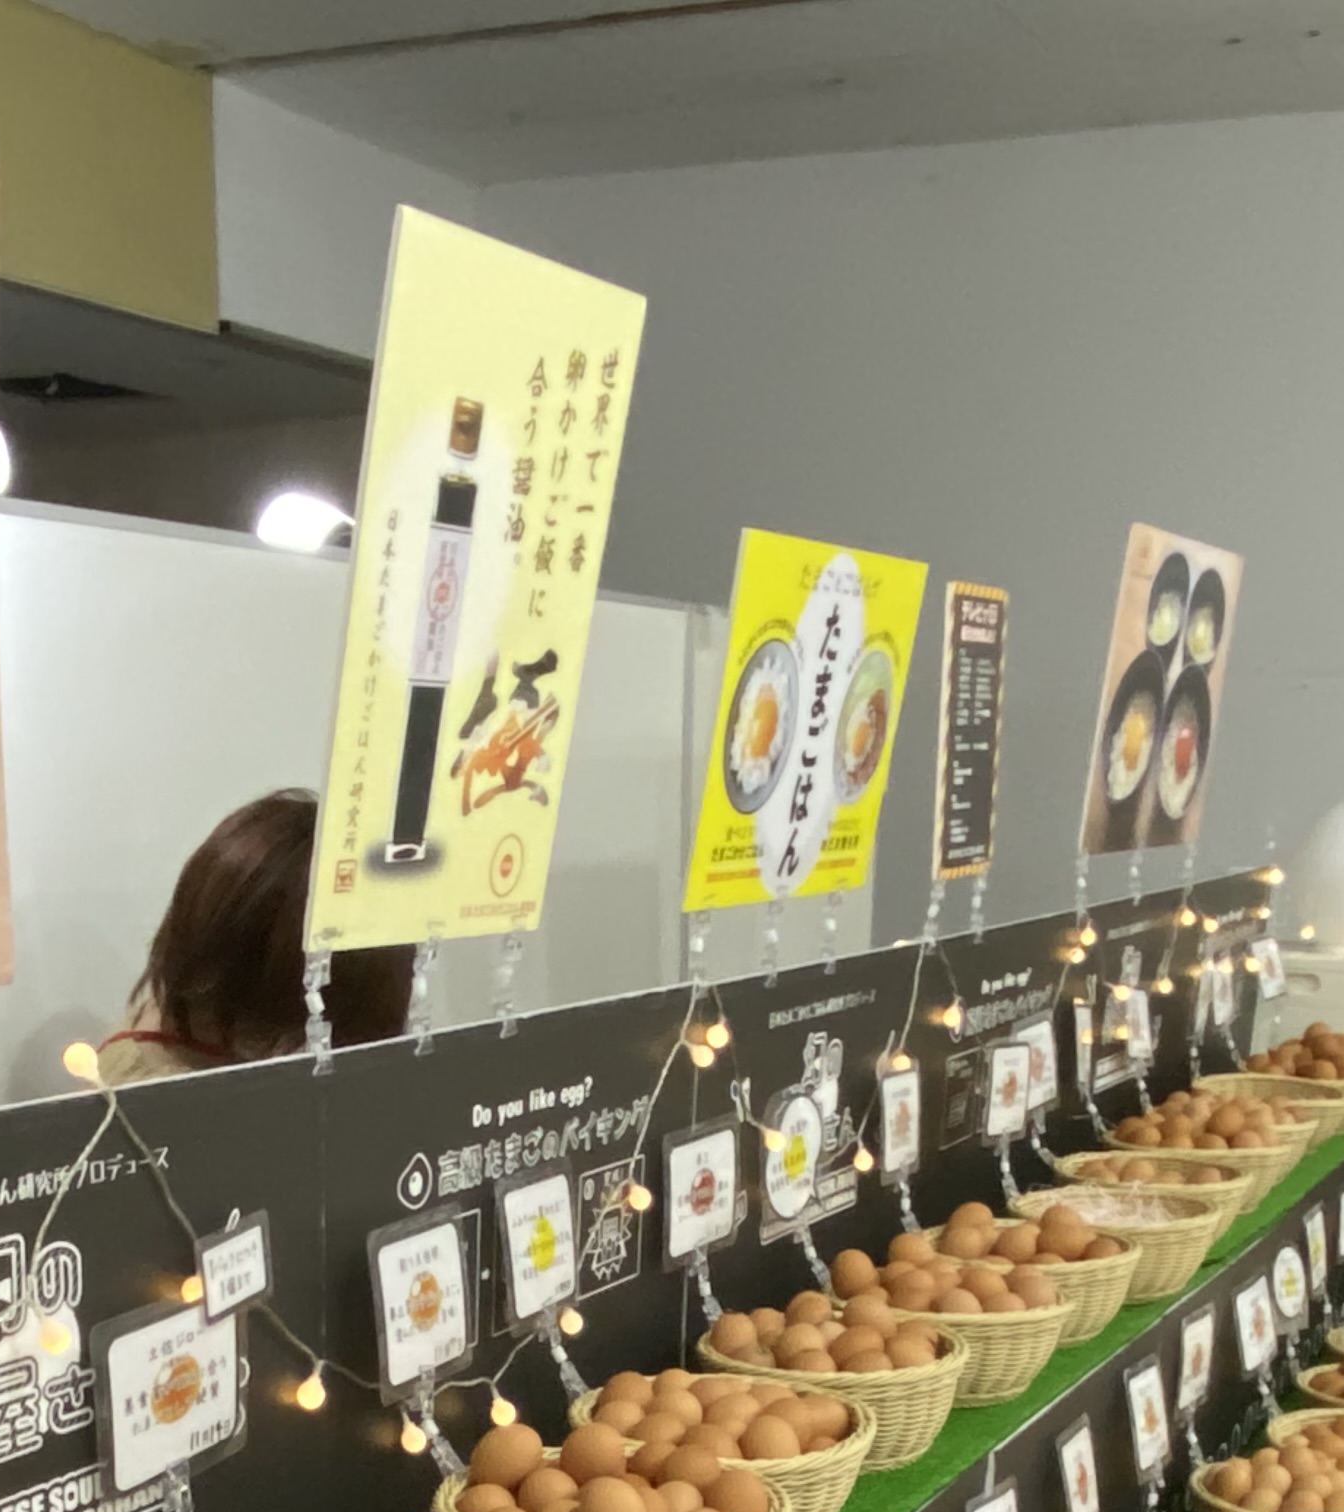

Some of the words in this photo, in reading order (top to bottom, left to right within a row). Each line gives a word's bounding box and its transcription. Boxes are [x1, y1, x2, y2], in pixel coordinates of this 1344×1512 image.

[569, 348, 618, 573] 世界で一番
[472, 1104, 492, 1128] Do
[497, 1099, 524, 1127] you
[529, 1086, 556, 1112] like
[559, 1075, 594, 1108] egg?
